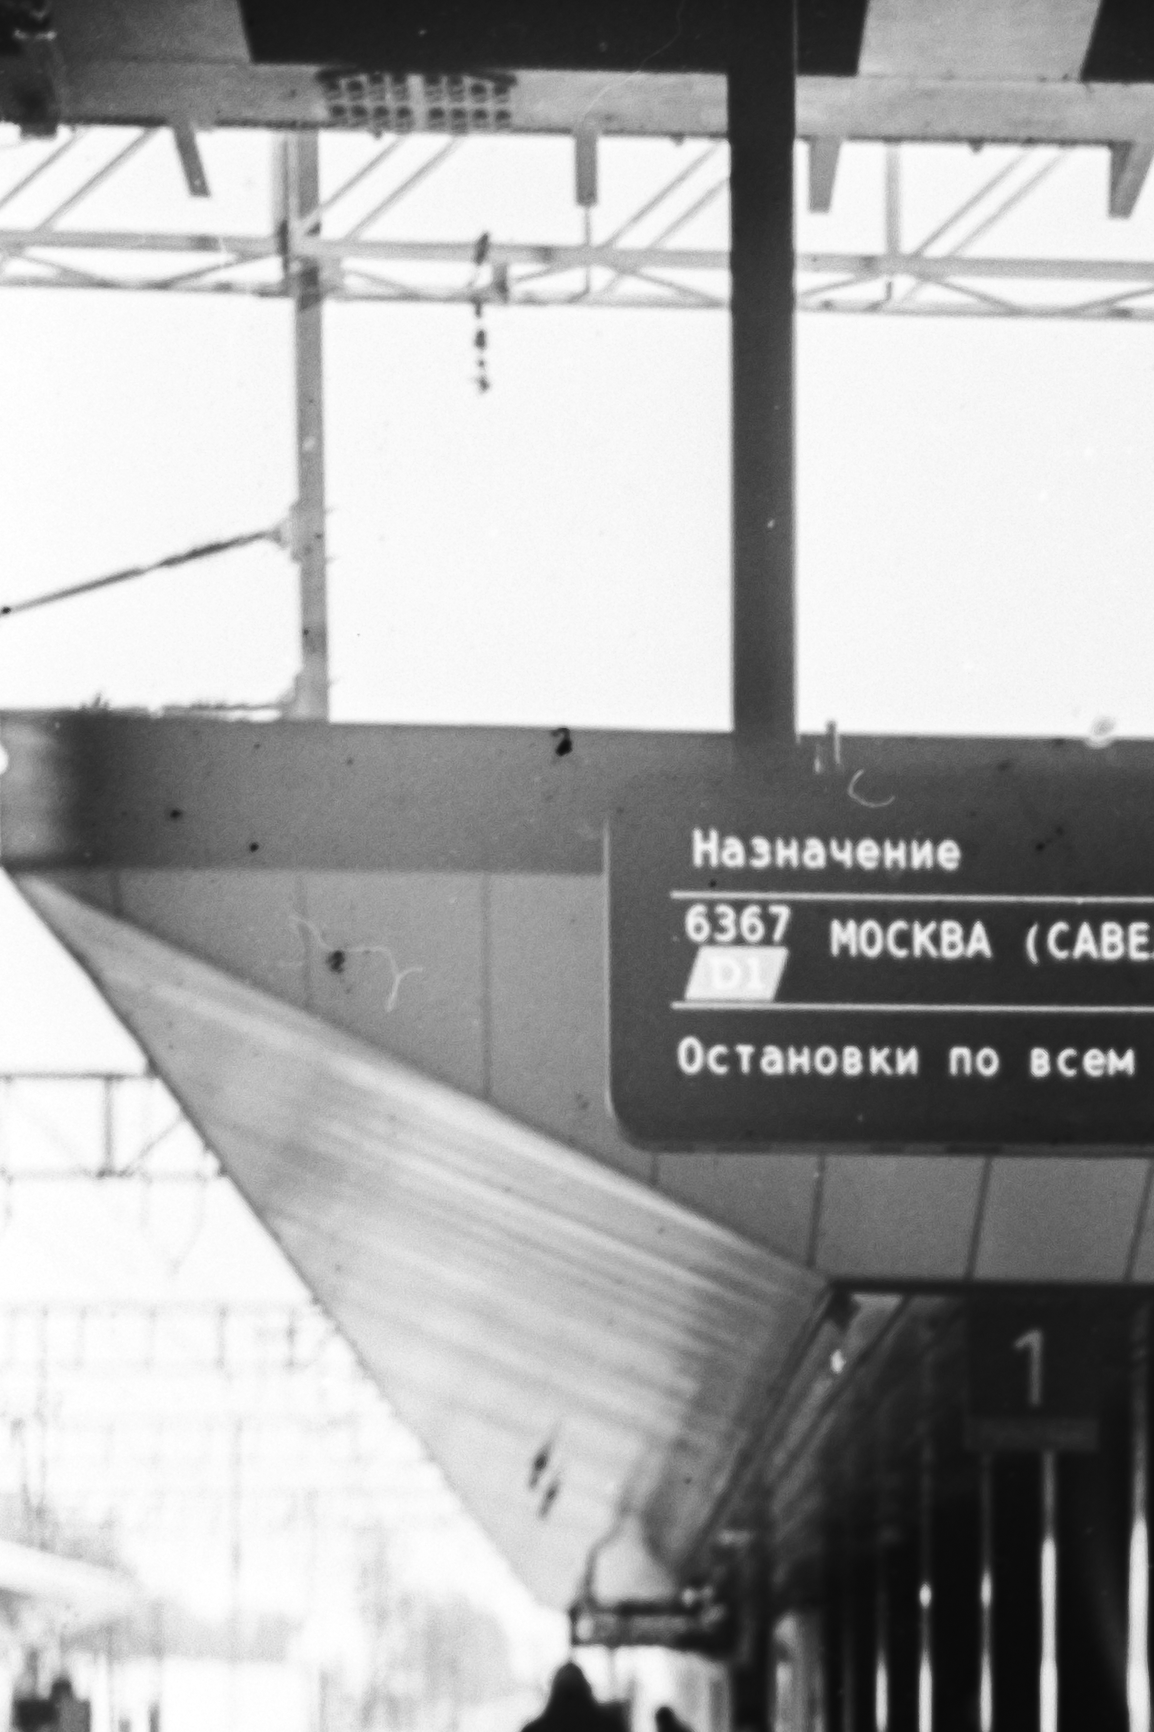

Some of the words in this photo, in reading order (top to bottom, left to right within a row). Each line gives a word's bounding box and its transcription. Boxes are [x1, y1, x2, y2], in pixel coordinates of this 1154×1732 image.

[691, 826, 962, 871] Назначение
[684, 903, 792, 943] 6367
[830, 919, 992, 959] МОСКВА
[708, 955, 765, 990] D1
[676, 1036, 919, 1076] Остановки
[949, 1046, 1000, 1077] по
[1030, 1047, 1135, 1078] всем
[1014, 1328, 1043, 1405] 1
